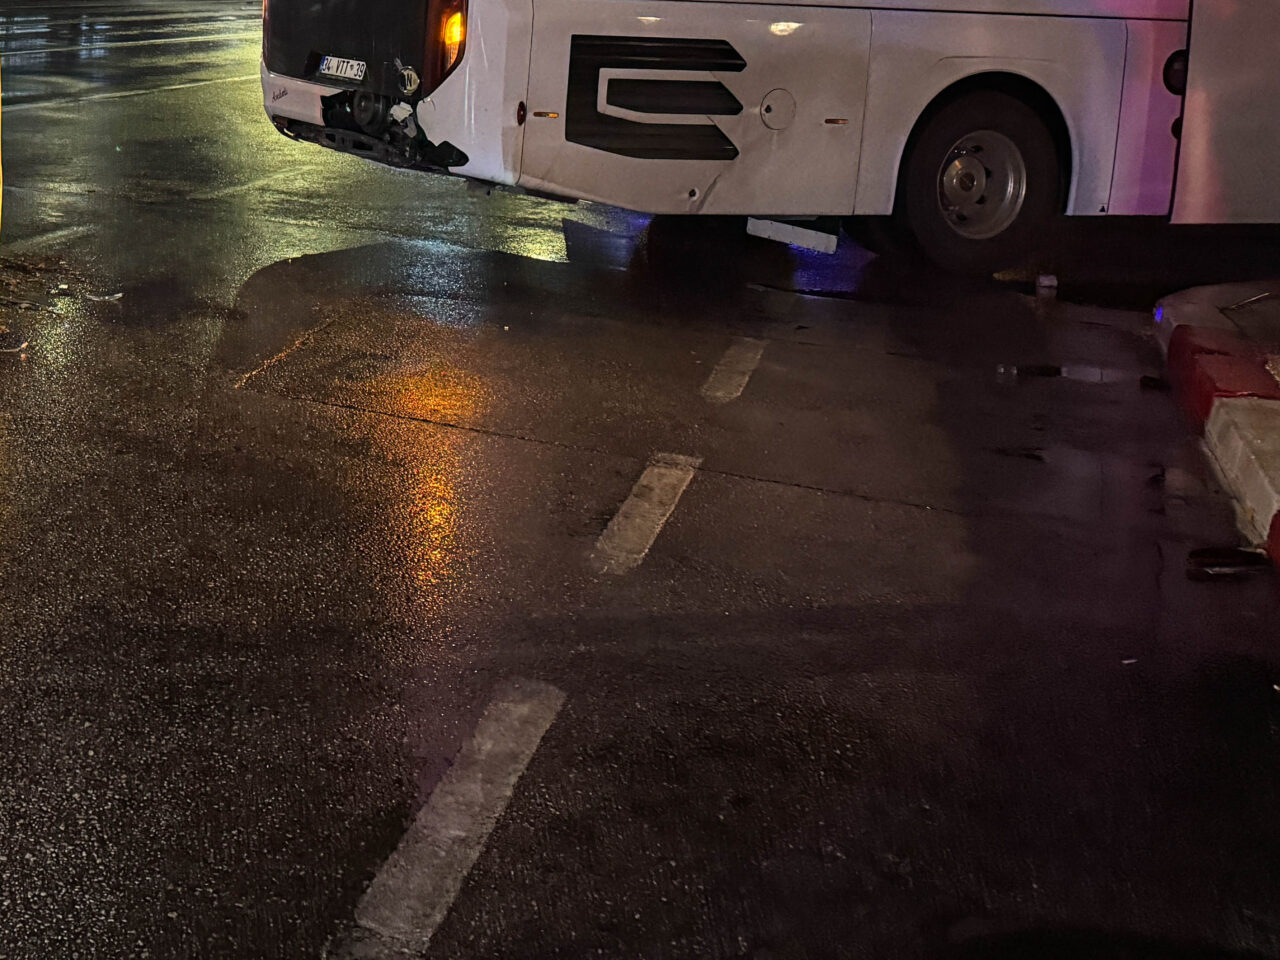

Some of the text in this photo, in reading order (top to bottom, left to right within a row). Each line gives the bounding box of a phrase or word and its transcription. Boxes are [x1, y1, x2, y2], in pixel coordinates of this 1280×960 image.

[323, 57, 366, 78] 34 VTT 39
